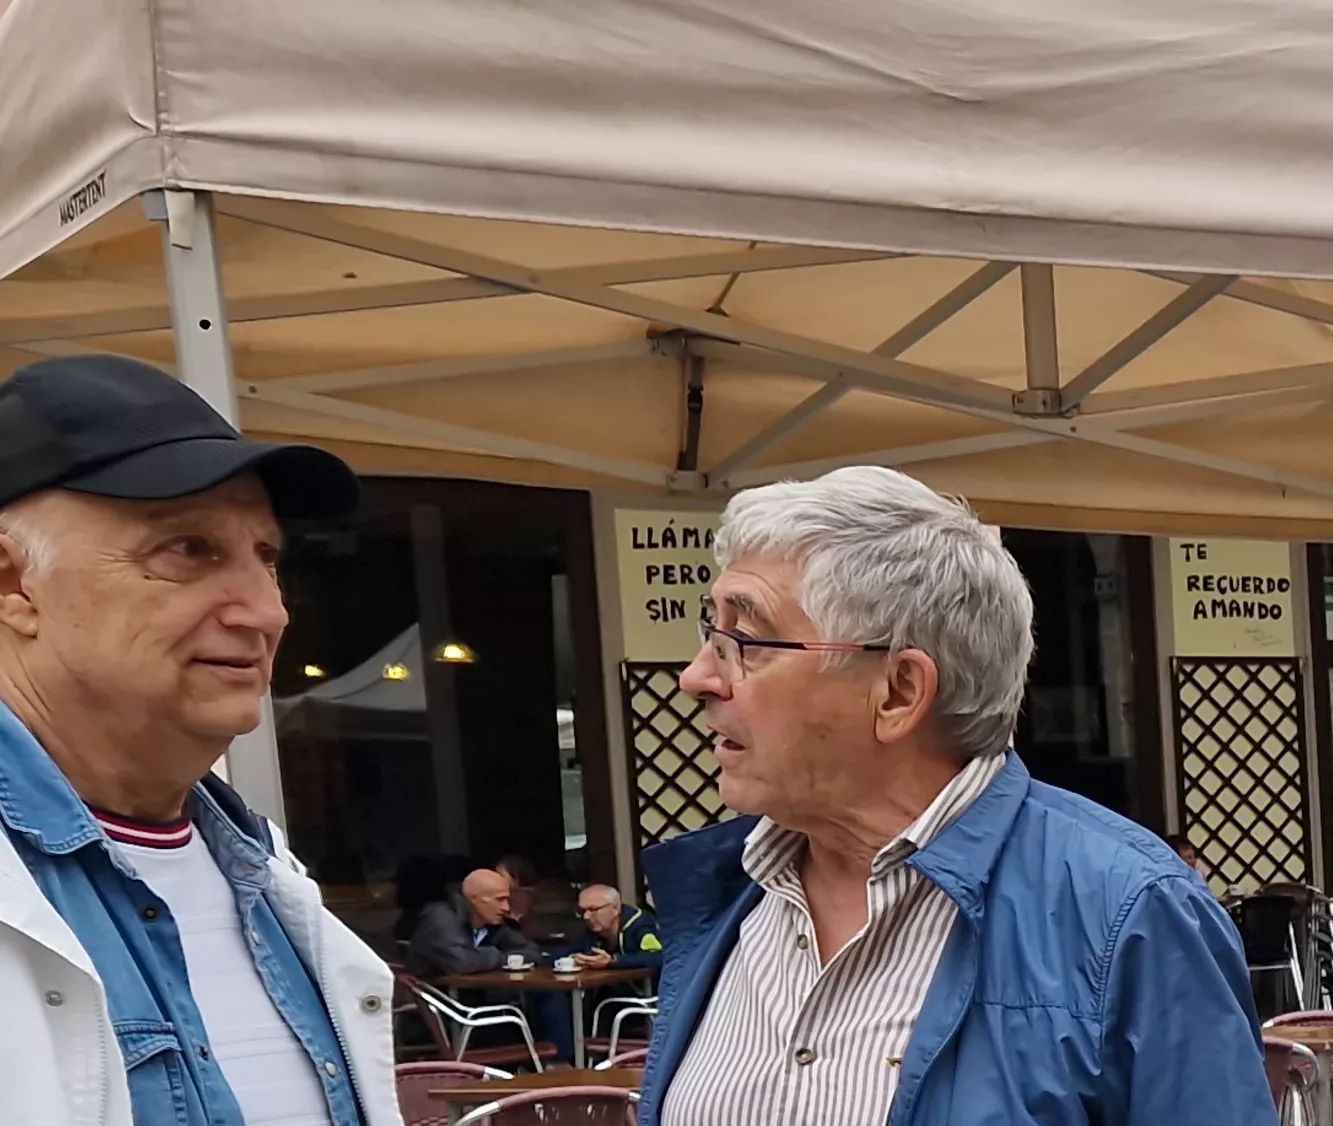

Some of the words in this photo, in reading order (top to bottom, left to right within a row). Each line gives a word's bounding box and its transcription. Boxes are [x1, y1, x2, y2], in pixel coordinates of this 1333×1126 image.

[59, 168, 107, 227] MASTERTENT
[1180, 543, 1208, 562] TE
[646, 564, 711, 585] PERO
[1187, 575, 1291, 595] RECUERDO
[645, 597, 686, 622] SIN
[1193, 599, 1283, 620] AMANDO
